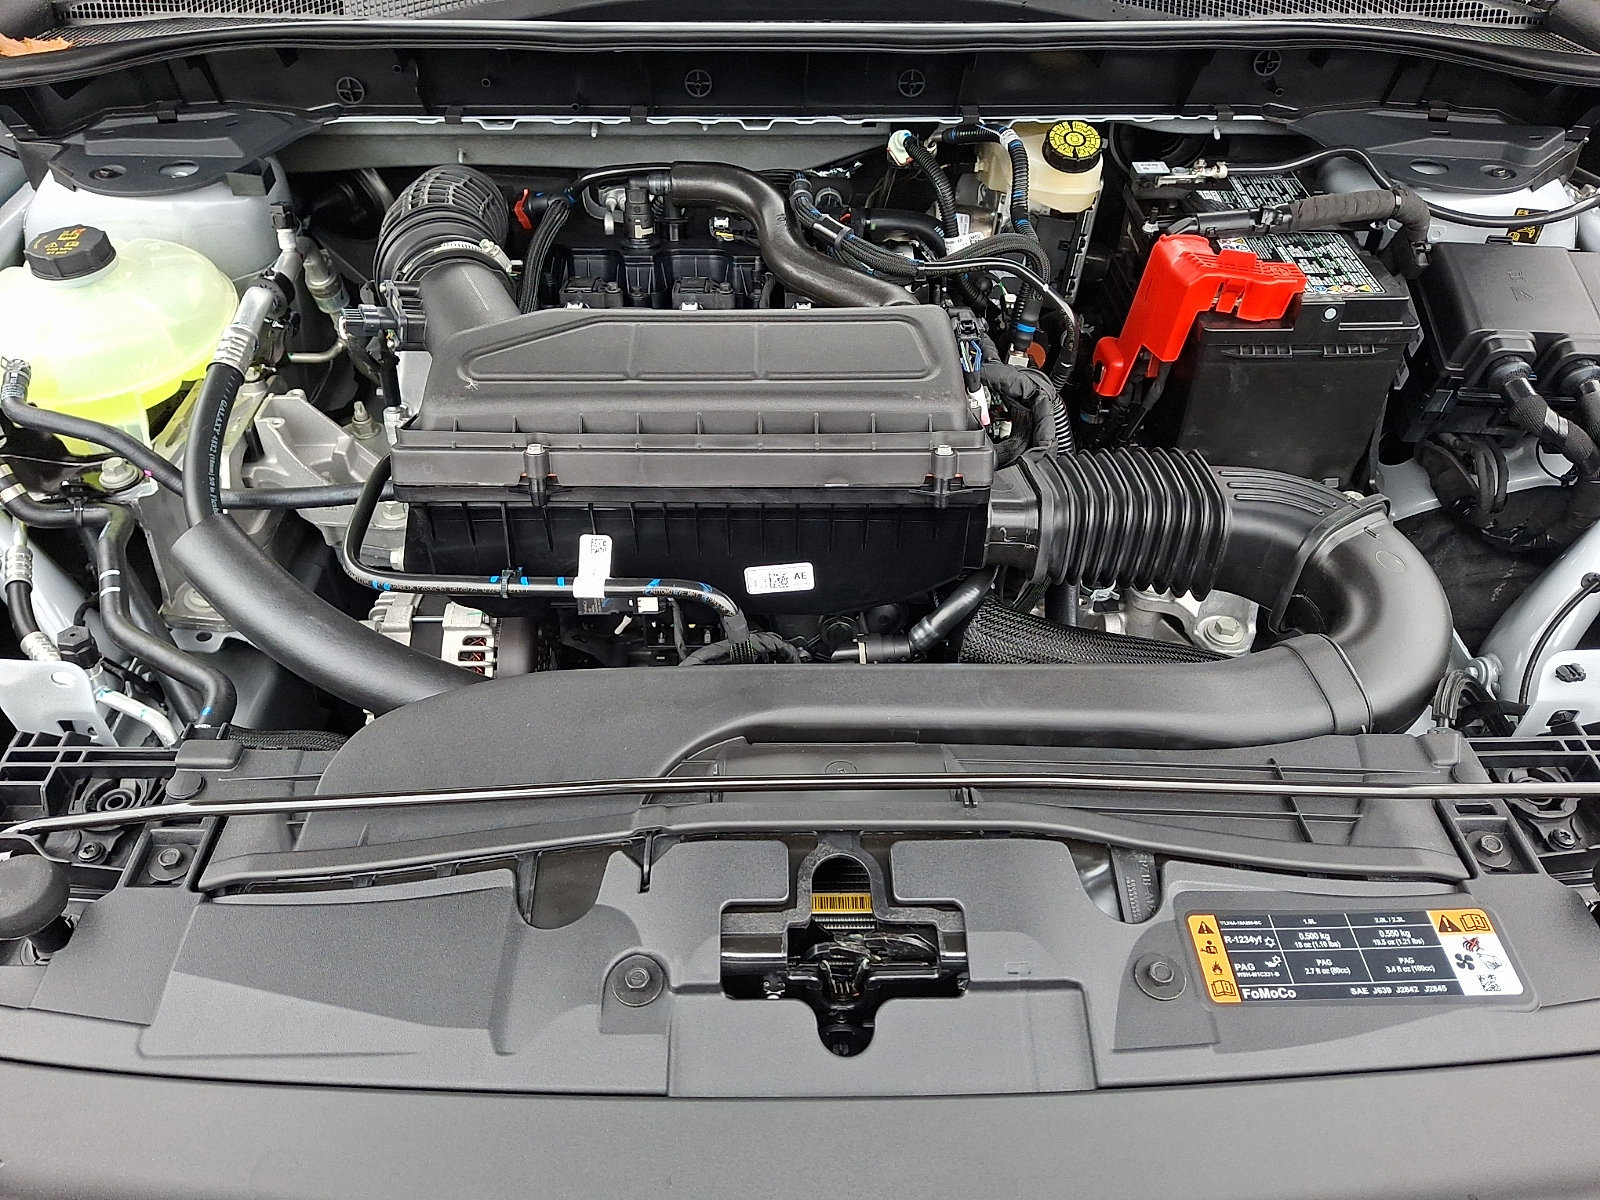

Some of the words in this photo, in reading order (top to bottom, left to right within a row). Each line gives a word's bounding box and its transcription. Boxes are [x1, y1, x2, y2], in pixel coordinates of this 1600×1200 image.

[212, 400, 228, 435] GALAXY
[793, 571, 807, 580] AE
[1298, 932, 1319, 941] 0.500
[1319, 932, 1331, 941] kg
[1399, 929, 1411, 939] kg
[1223, 935, 1263, 945] R-1234yf
[1234, 963, 1256, 971] PAG
[1411, 964, 1436, 973] (100cc)
[1242, 988, 1297, 999] FoMoCo
[1350, 987, 1370, 995] SAE
[1372, 986, 1392, 994] J639
